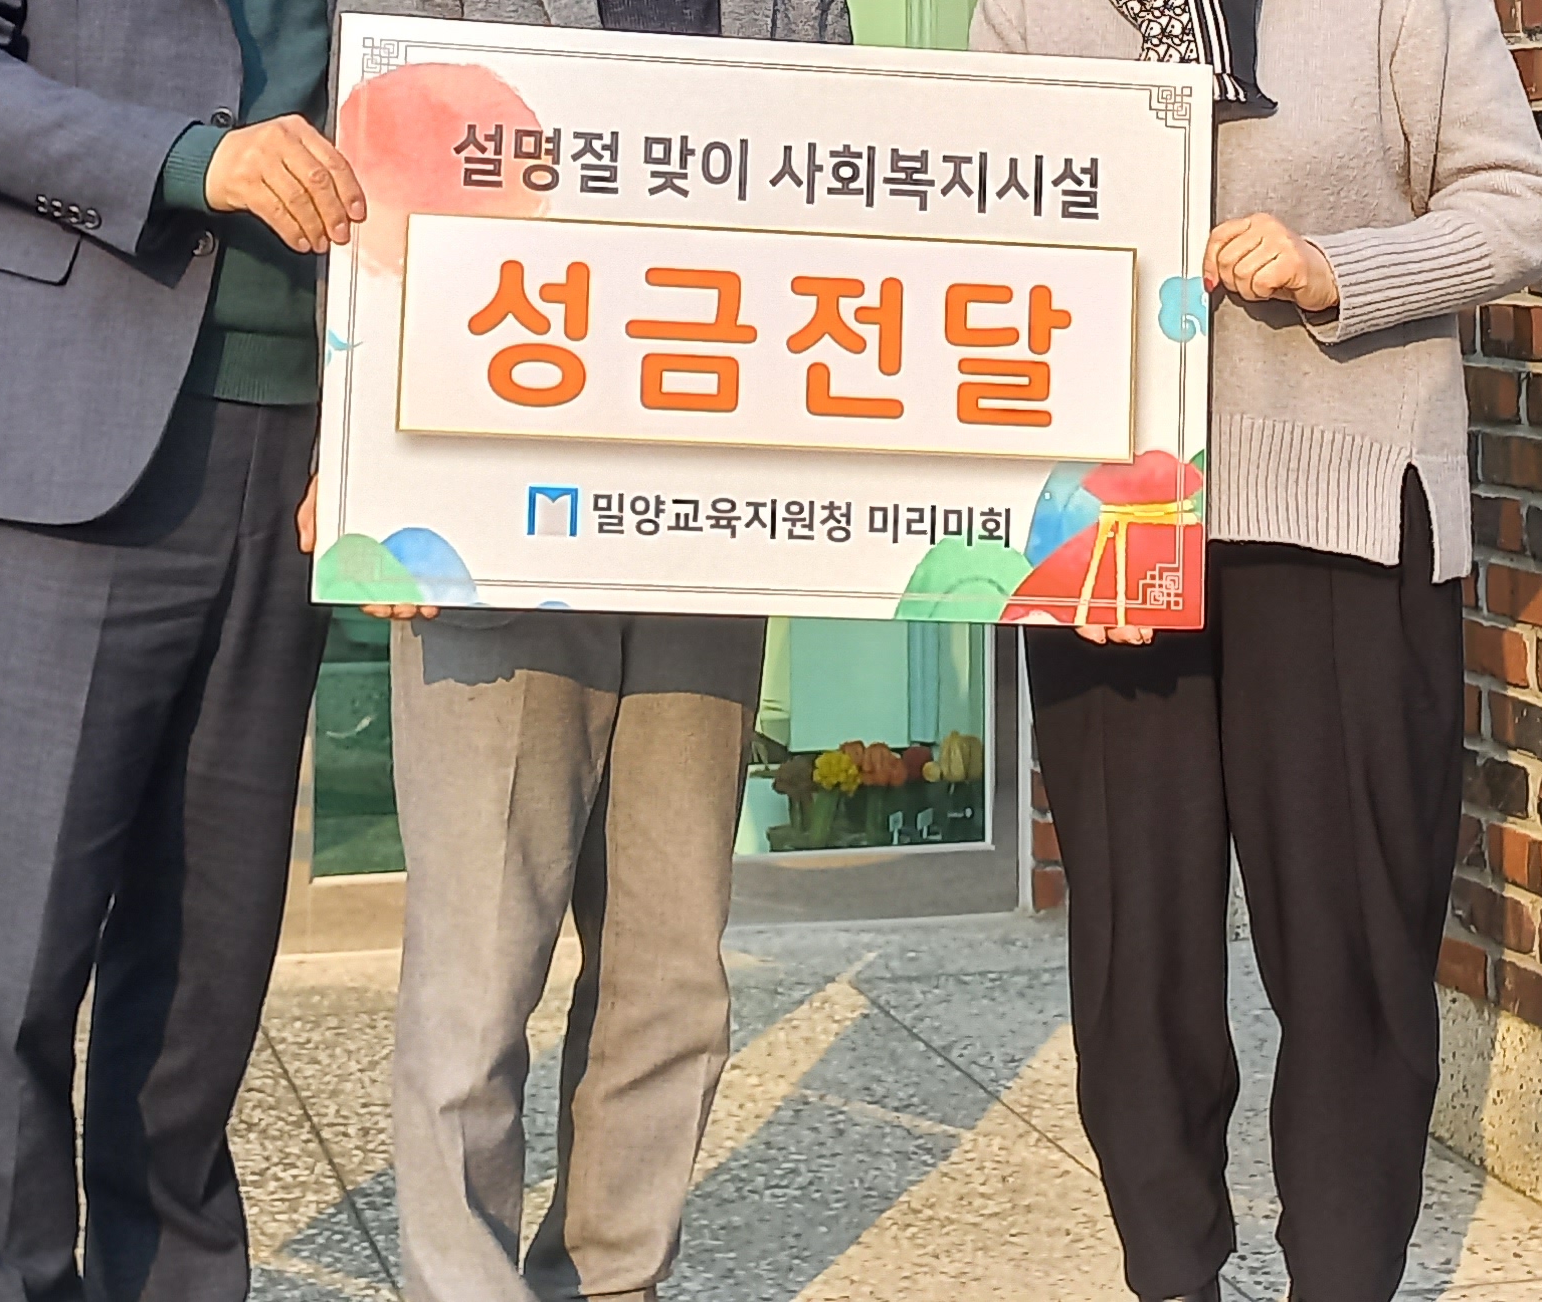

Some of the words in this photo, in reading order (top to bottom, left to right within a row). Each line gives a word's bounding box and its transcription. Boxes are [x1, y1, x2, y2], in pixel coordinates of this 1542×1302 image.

[452, 122, 621, 195] 설명절
[641, 134, 751, 202] 맞이
[768, 142, 1102, 221] 사회복지시설
[467, 259, 1073, 427] 성금전달
[592, 491, 854, 544] 밀양교육지원청
[867, 502, 1012, 549] 미리미회
